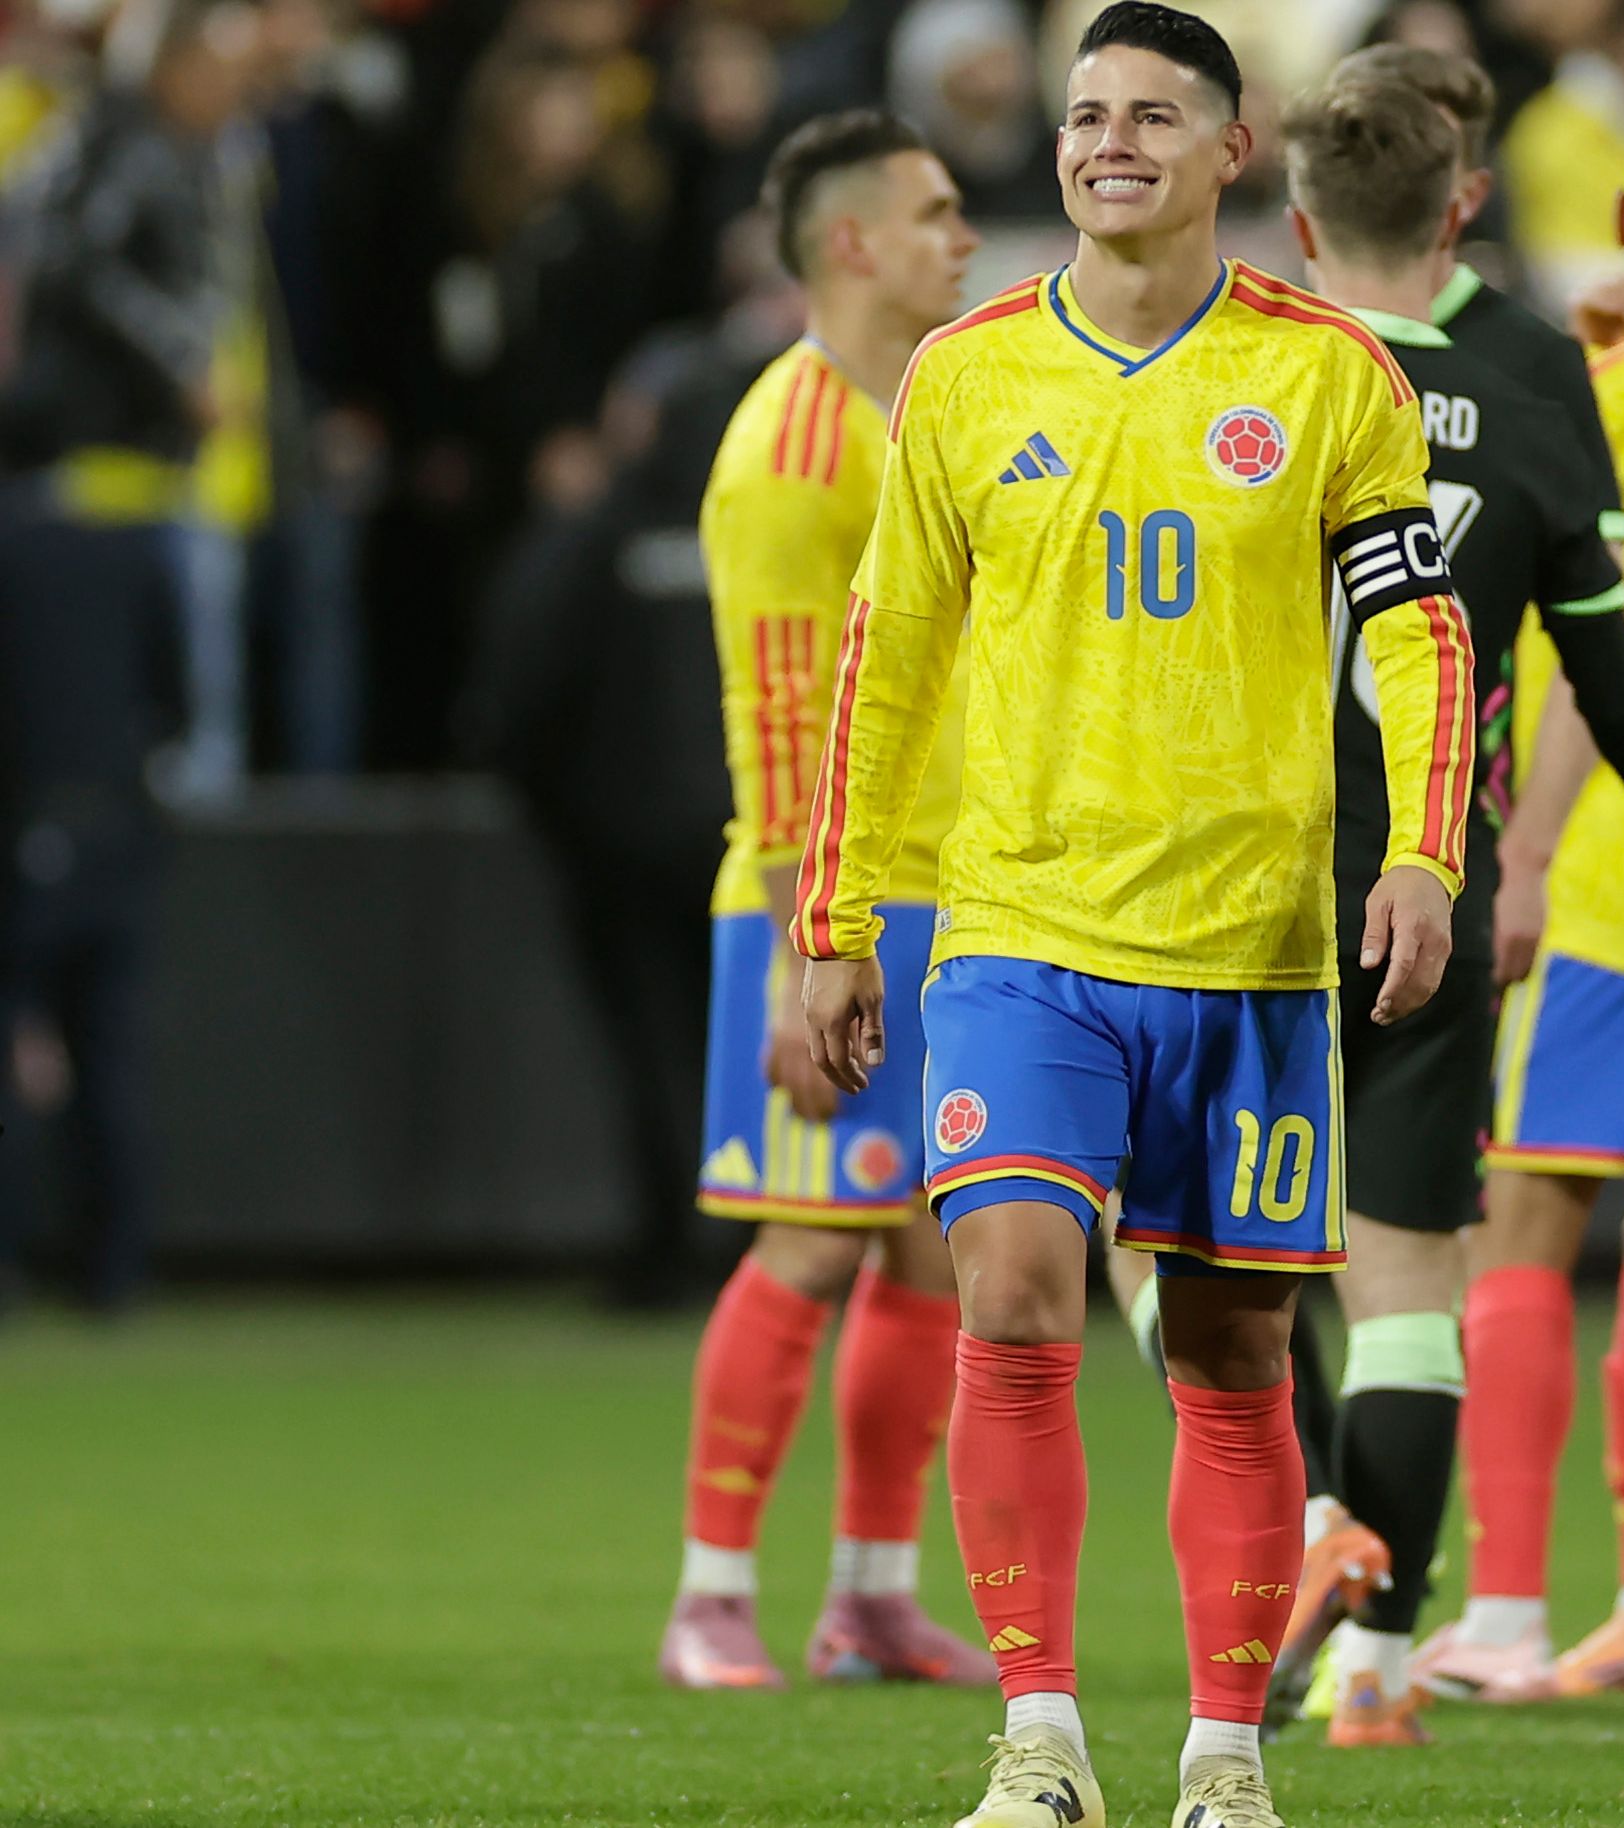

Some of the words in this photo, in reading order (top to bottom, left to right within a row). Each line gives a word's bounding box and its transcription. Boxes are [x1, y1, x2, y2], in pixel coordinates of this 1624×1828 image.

[1098, 508, 1196, 620] 10
[1229, 1108, 1316, 1223] 10
[970, 1563, 1027, 1590] FCF
[1231, 1580, 1290, 1599] FCF
